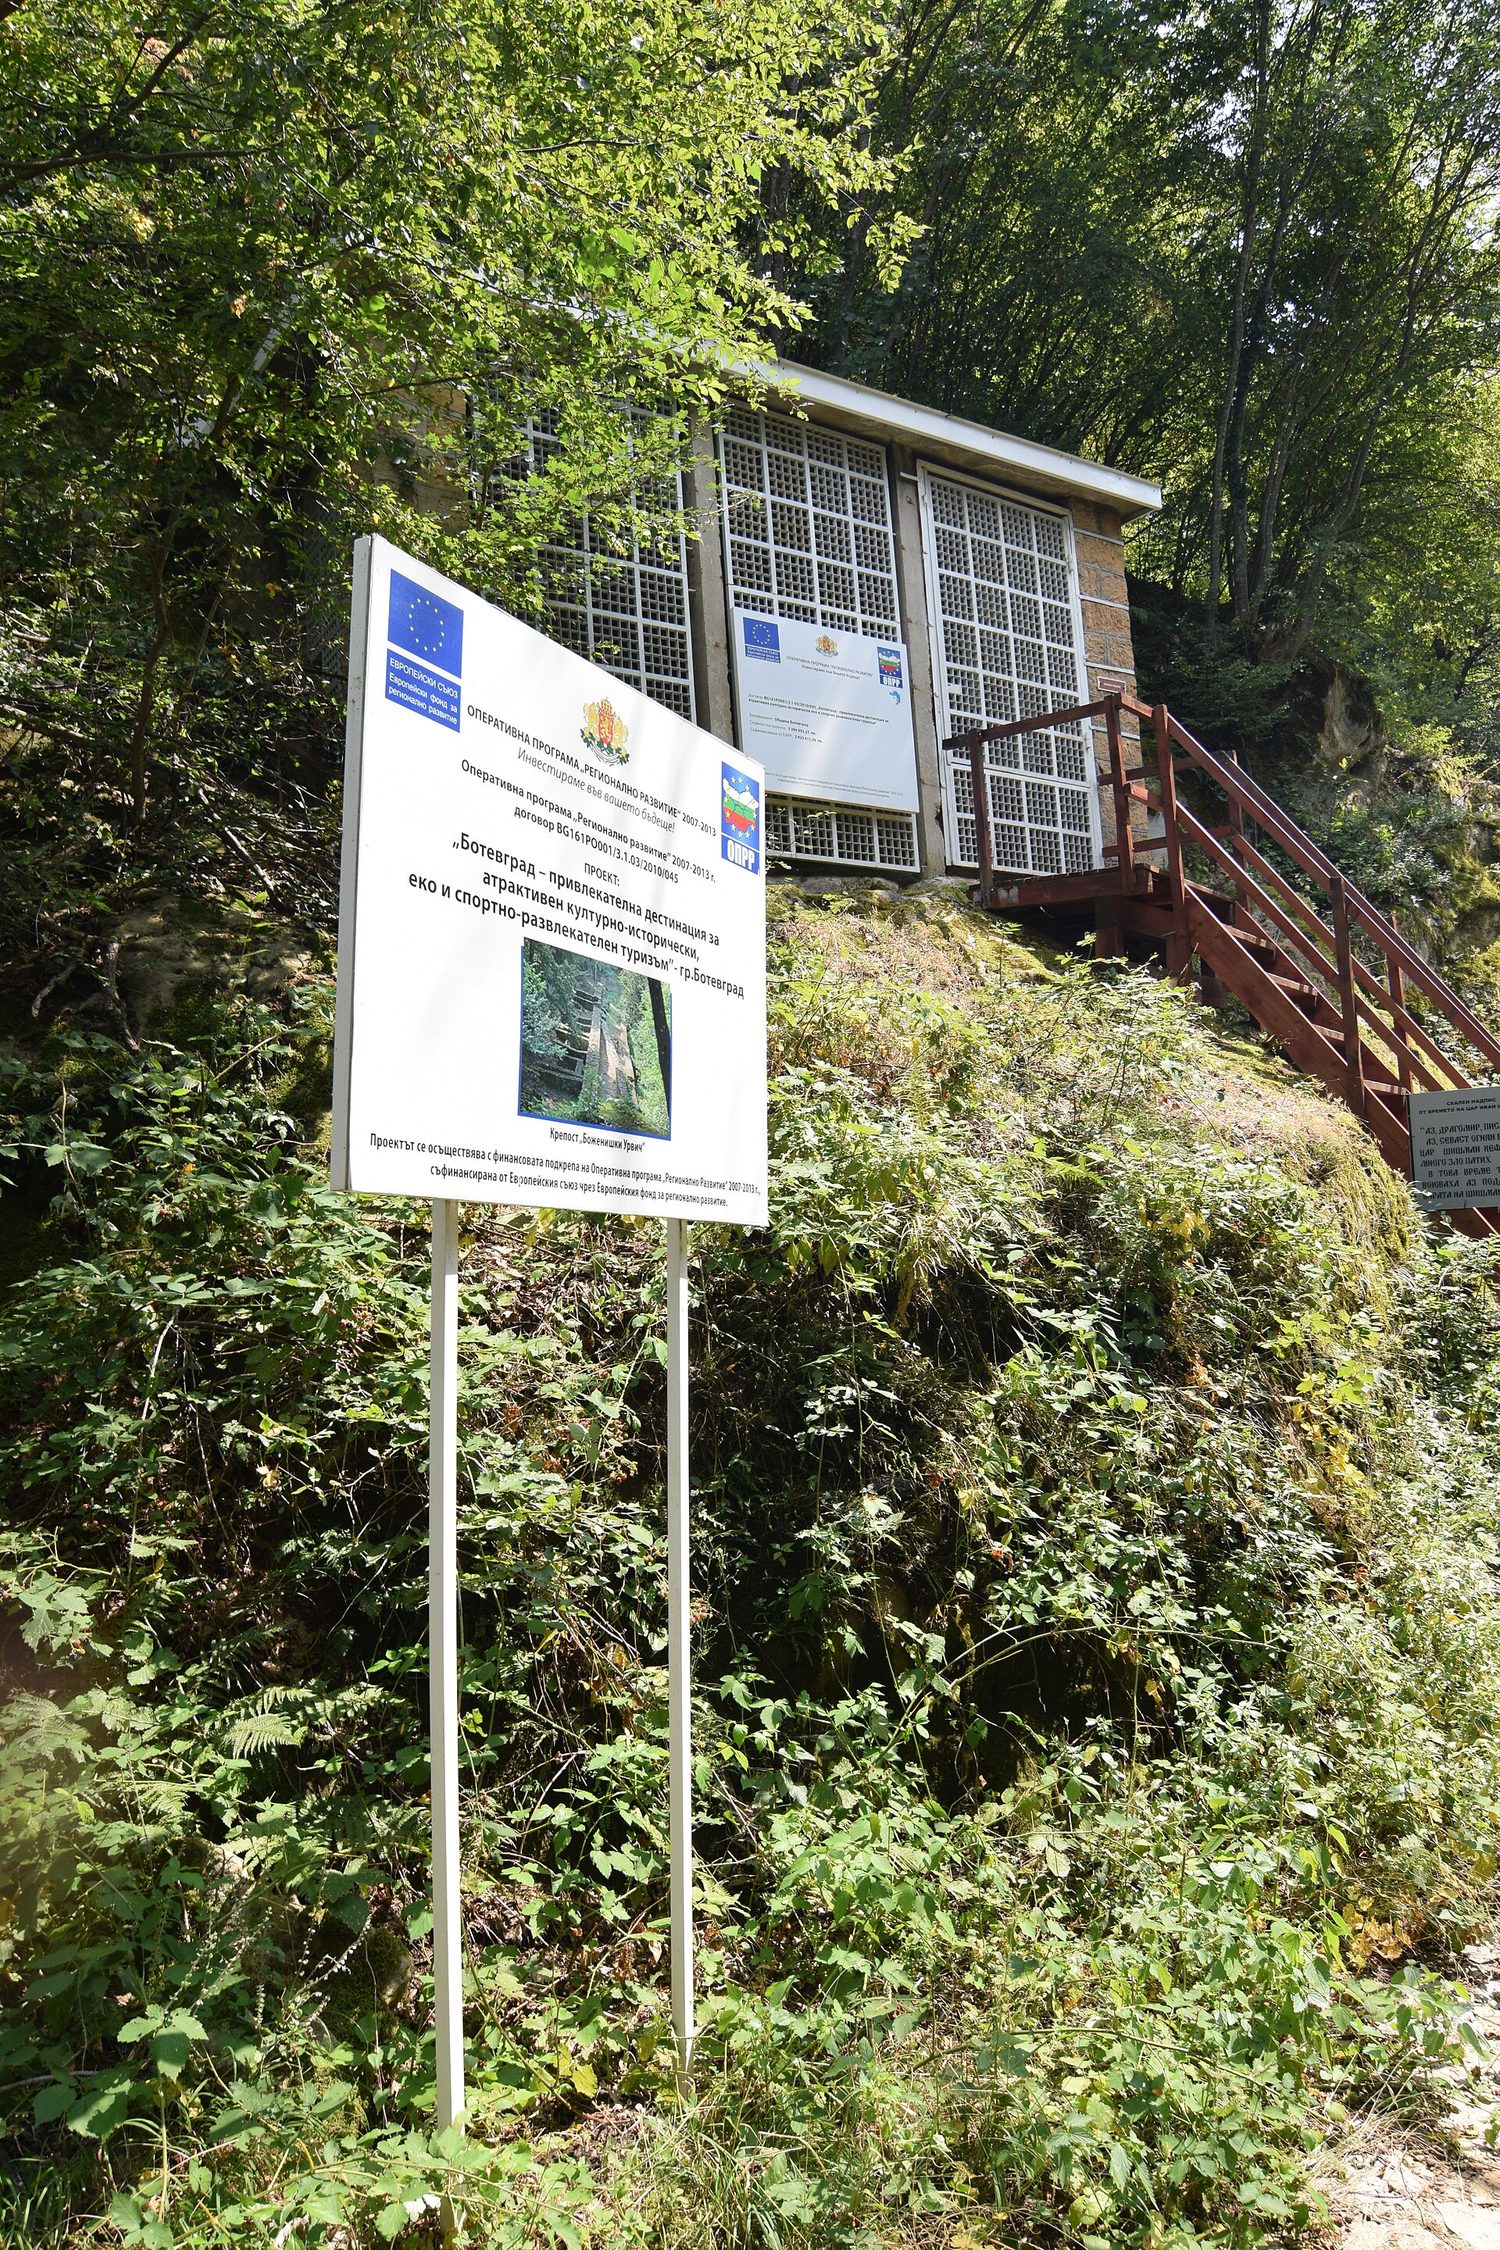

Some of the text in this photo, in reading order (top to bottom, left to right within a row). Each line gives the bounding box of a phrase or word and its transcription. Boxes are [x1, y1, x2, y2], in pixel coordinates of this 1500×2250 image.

[389, 672, 457, 713] Европейски фонд за
[390, 657, 458, 699] ЕВРОПЕЙСКИ СЪЮЗ
[882, 676, 900, 688] ОПРР
[388, 686, 457, 724] регионално развитие
[467, 704, 530, 746] ОПЕРАТИВНА
[532, 736, 579, 770] ПРОГРАМА
[682, 812, 716, 837] 2007-2013
[517, 747, 675, 833] Инвестираме във вашето бъдеще!
[461, 759, 524, 797] Оперативна
[526, 790, 572, 819] програма
[671, 854, 709, 880] 2007-2013
[710, 874, 716, 883] г.
[513, 806, 678, 884] договор BG161PO001/3.1.03/2010/045
[727, 839, 755, 870] ОПРР
[584, 862, 620, 887] ПРОЕКТ:
[408, 873, 437, 894] еко
[441, 883, 450, 899] и
[454, 889, 618, 954] спортно-развлекателен
[482, 871, 699, 962] атрактивен културно-исторически,
[549, 870, 642, 917] привлекателна
[644, 908, 706, 941] дестинация
[708, 933, 719, 946] за
[549, 1127, 579, 1142] Крепост
[1439, 1135, 1469, 1144] СЕВАСТ
[1470, 1133, 1495, 1142] ОГНЯН
[1483, 1121, 1500, 1130] ПИС
[370, 1132, 415, 1151] Проектът
[416, 1142, 426, 1152] се
[427, 1143, 486, 1160] осъществява
[487, 1151, 491, 1161] с
[492, 1149, 544, 1167] финансовата
[544, 1159, 580, 1173] подкрепа
[580, 1164, 589, 1173] на
[590, 1162, 631, 1178] Оперативна
[631, 1170, 662, 1183] програма
[728, 1180, 754, 1194] 2007-2013
[1419, 1148, 1434, 1157] ЦАР
[1442, 1145, 1480, 1155] ШИШМАН
[1420, 1155, 1491, 1167] МНОГО ЗЛО ПАТИХ
[430, 1163, 728, 1206] съфинансирана от Европейския съюз чрез Европейския фонд за регионално развитие.
[1422, 1179, 1459, 1189] ВОЮВАХА
[1466, 1178, 1476, 1186] АЗ
[1438, 1168, 1458, 1177] ТОВА
[1463, 1166, 1491, 1175] ВРЕМЕ
[1422, 1190, 1452, 1200] РАТА
[1453, 1190, 1464, 1198] НА
